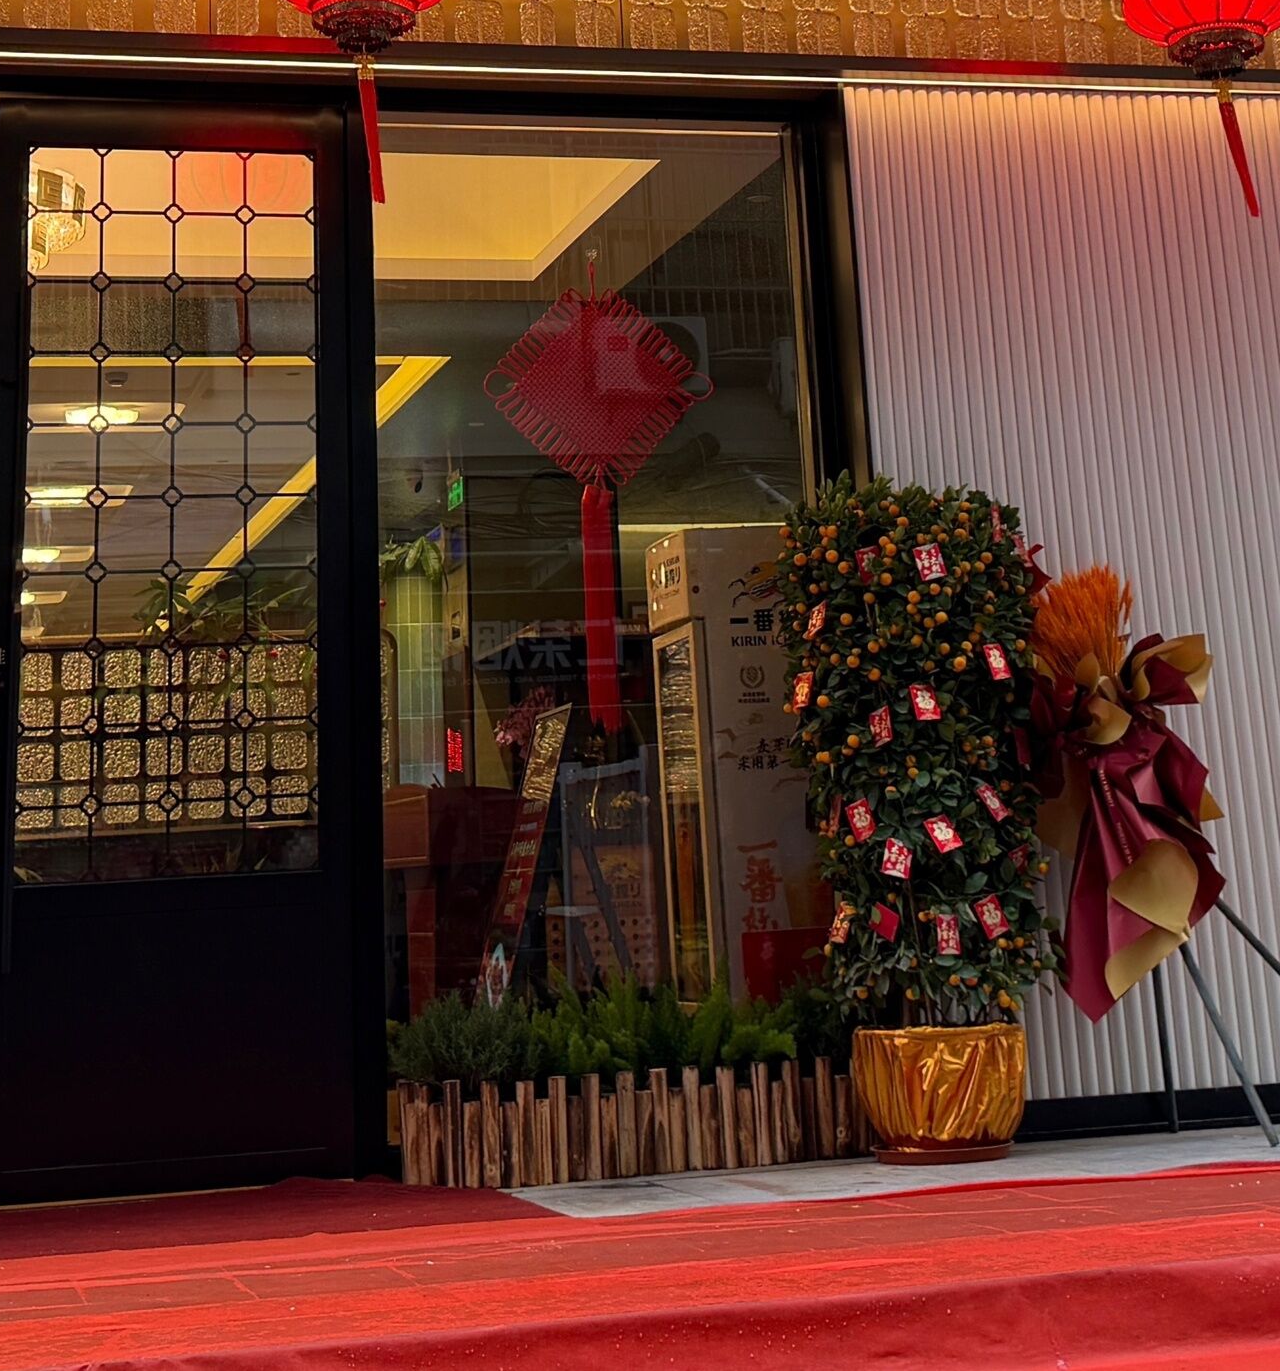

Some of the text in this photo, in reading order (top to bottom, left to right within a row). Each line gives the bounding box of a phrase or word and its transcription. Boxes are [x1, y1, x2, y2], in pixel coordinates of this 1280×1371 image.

[731, 635, 767, 646] KIRIN
[991, 647, 1006, 667] 福
[915, 689, 935, 710] 福
[853, 806, 870, 828] 福
[933, 821, 954, 841] 福
[983, 903, 1001, 924] 福
